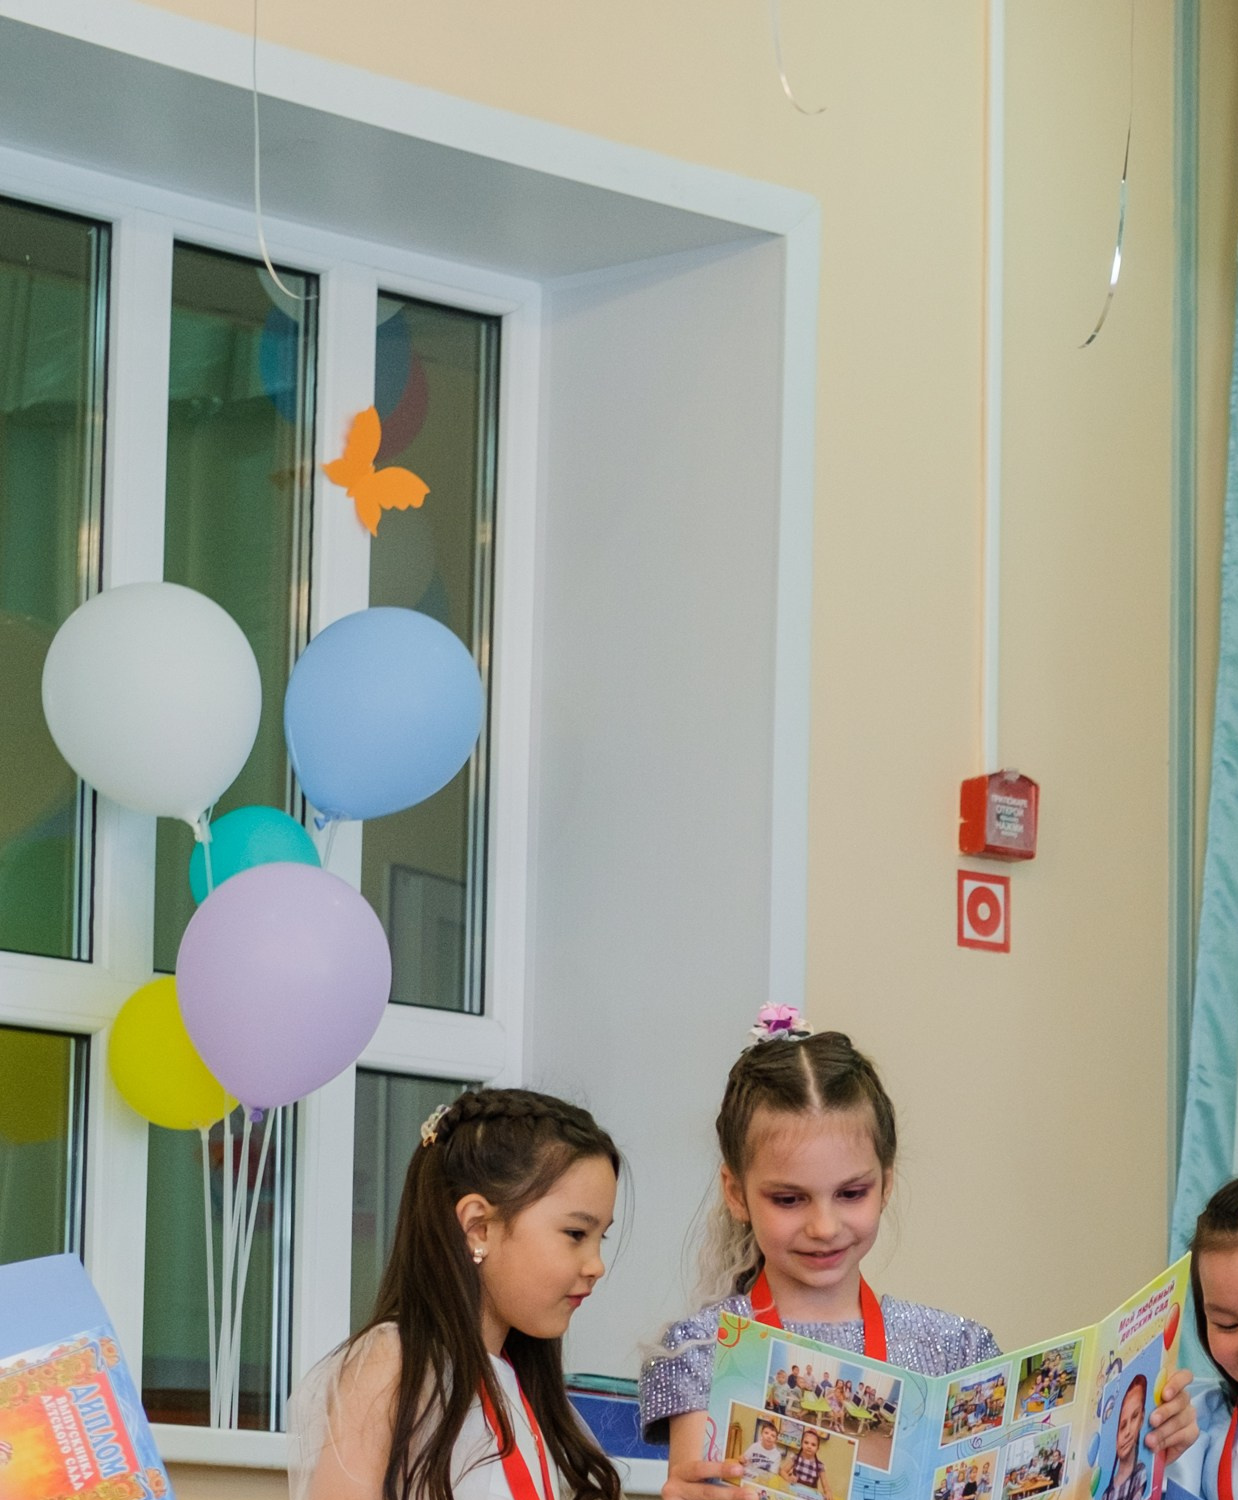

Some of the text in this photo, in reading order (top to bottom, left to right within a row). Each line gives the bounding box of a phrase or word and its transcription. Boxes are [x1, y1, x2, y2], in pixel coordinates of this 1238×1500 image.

[40, 1395, 85, 1491] ДЕТСКОГО САДА
[55, 1396, 94, 1480] ВЫПУСКНИКА
[68, 1384, 128, 1478] ДИПЛОМ
